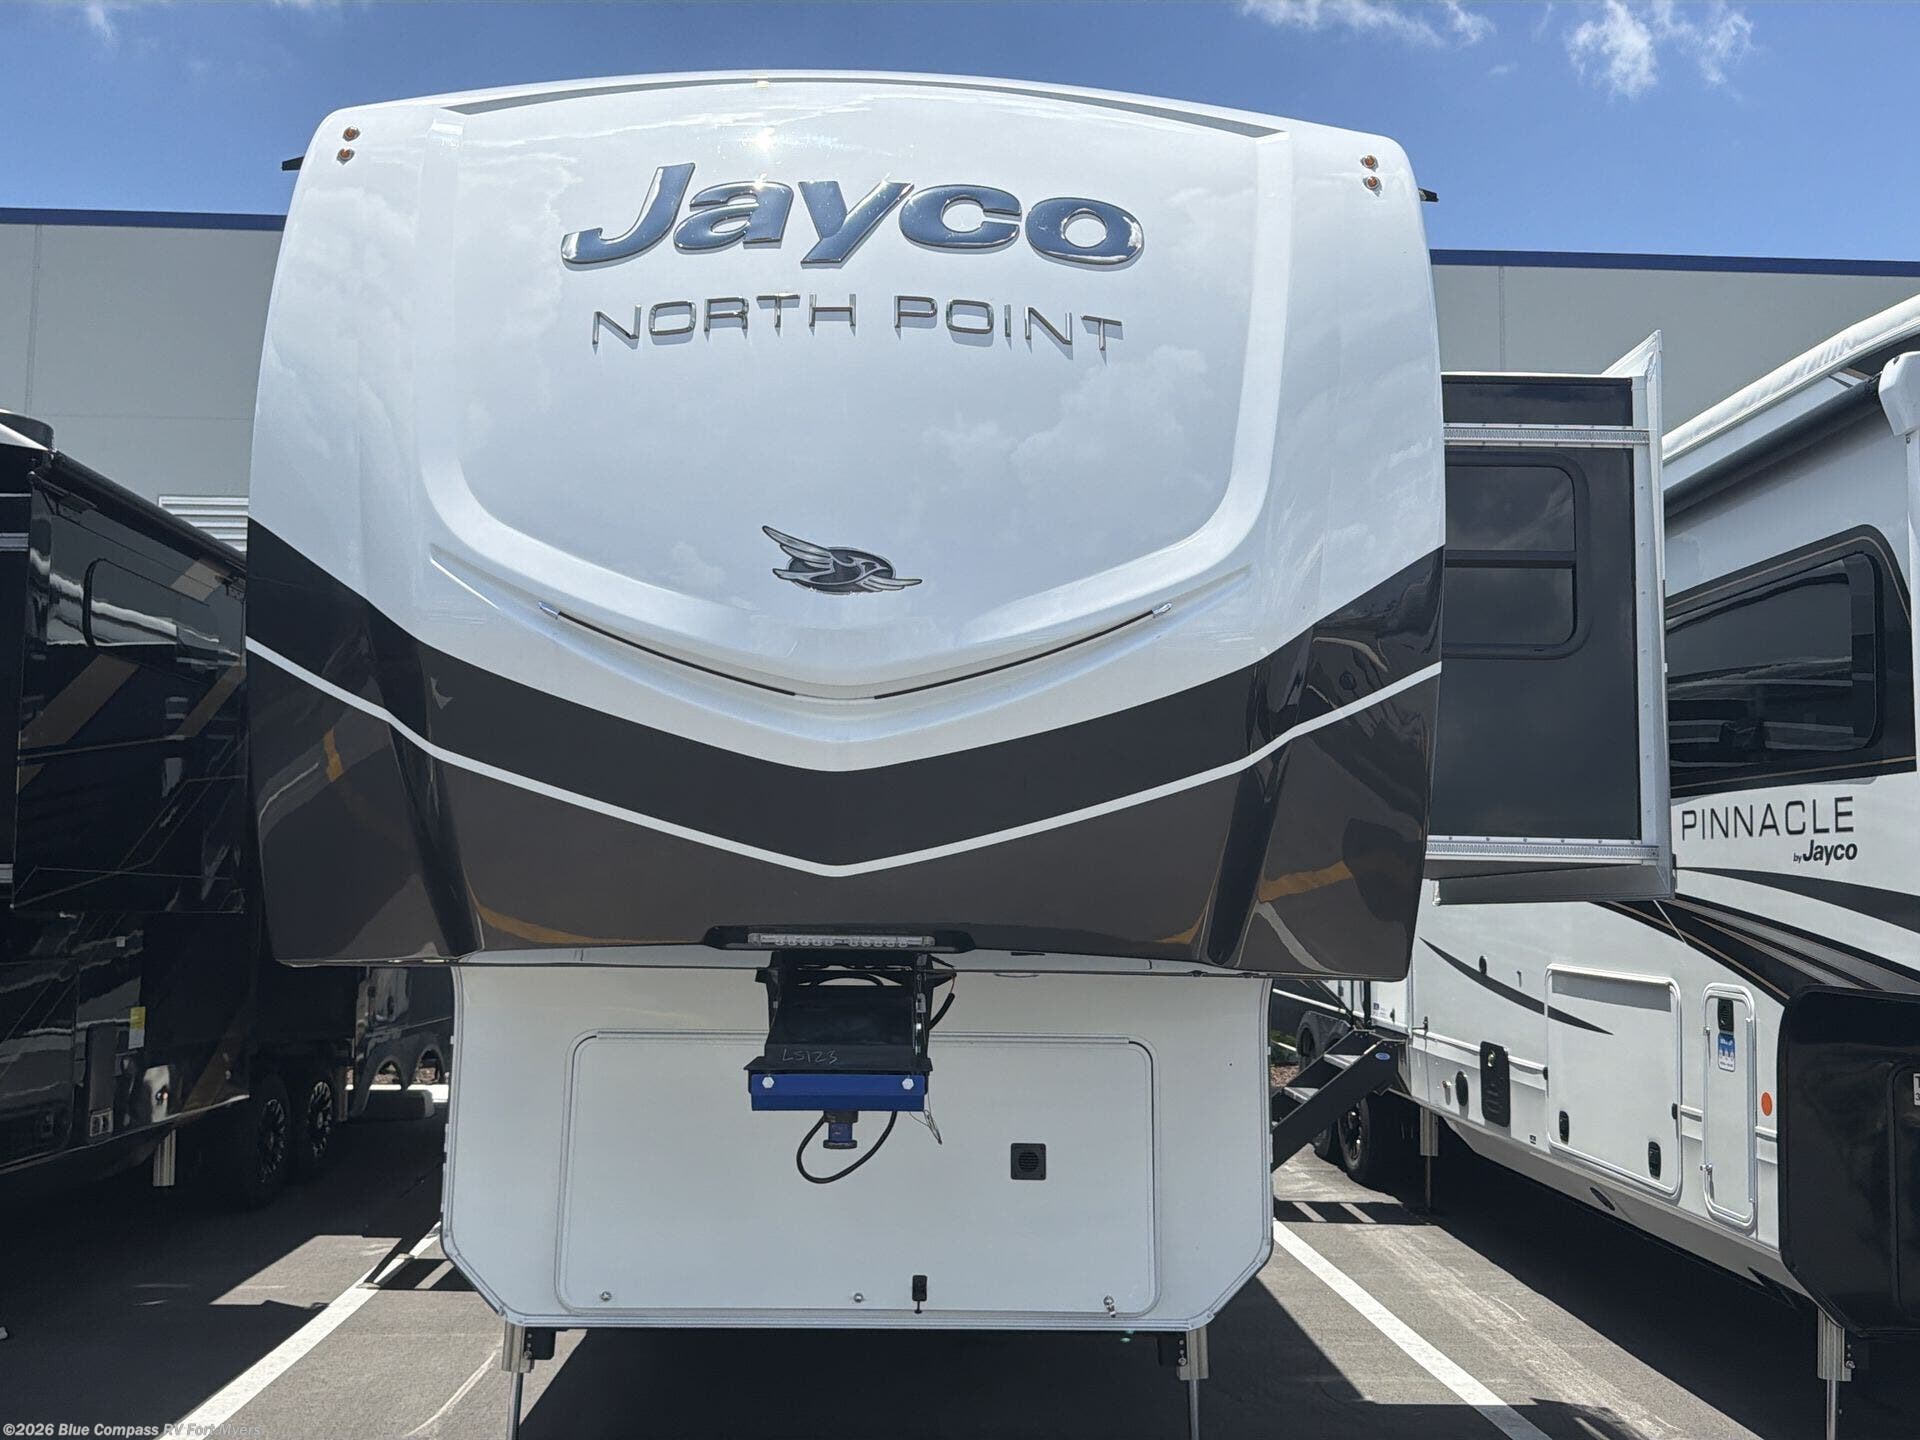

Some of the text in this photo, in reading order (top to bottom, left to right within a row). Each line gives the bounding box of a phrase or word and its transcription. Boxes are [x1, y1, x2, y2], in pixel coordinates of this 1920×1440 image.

[560, 161, 1145, 269] Jayco
[592, 292, 1123, 351] NORTH POINT
[1681, 796, 1854, 841] PINNACLE
[1792, 839, 1858, 866] by Jayco
